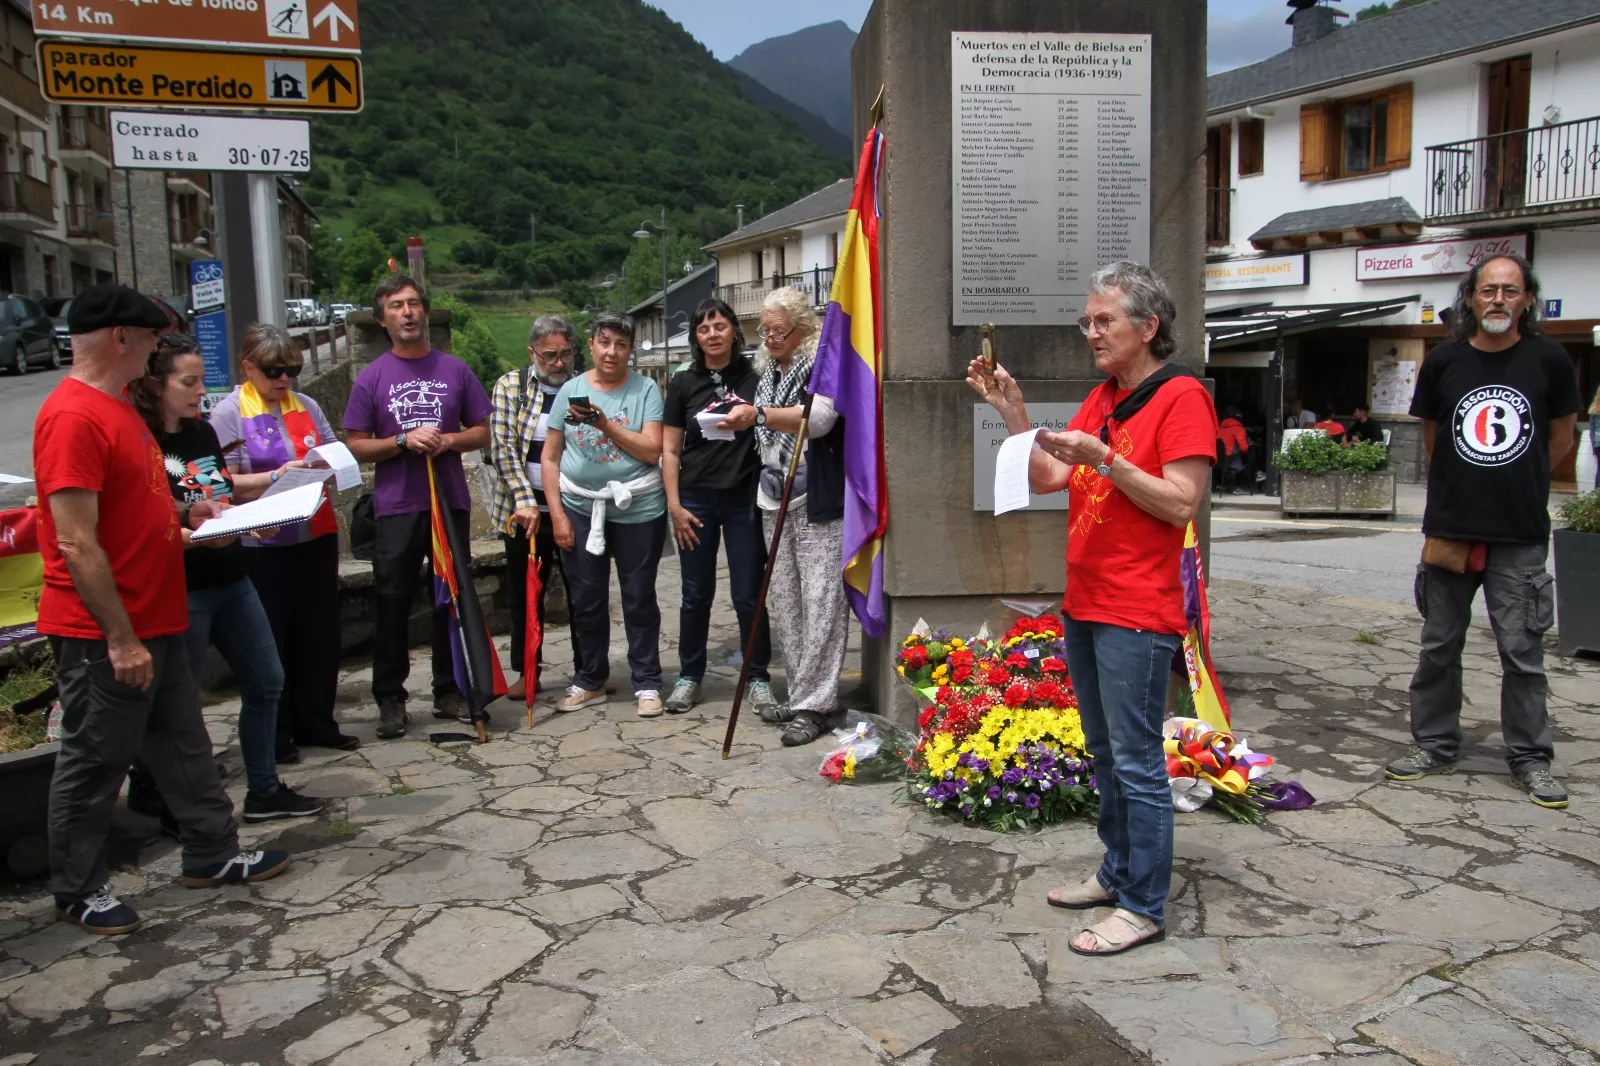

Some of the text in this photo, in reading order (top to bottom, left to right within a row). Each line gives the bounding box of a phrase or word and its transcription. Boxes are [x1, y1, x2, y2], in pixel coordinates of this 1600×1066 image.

[39, 3, 114, 25] 14 Km
[961, 40, 1008, 50] Muertos
[1030, 41, 1040, 50] el
[1044, 41, 1071, 51] Valle
[1075, 42, 1089, 52] de
[1093, 42, 1125, 52] Bielsa
[1129, 44, 1142, 52] en
[51, 50, 137, 68] parador
[972, 54, 1132, 67] defensa de la República y la
[982, 68, 1122, 80] Democracia (1936-1939)
[53, 70, 253, 99] Monte Perdido
[975, 84, 983, 92] EL
[116, 119, 199, 139] Cerrado
[132, 146, 198, 162] hasta
[1237, 263, 1292, 276] RESTAURANTE
[1364, 255, 1413, 271] Pizzería
[389, 378, 448, 396] Asociación
[1458, 389, 1527, 418] ABSOLUCIÓN
[982, 420, 994, 429] En
[1041, 420, 1054, 429] de
[1055, 420, 1068, 429] los
[1475, 405, 1507, 447] 6
[1457, 436, 1527, 461] ANTIFASCISTAS ZARAGOZA
